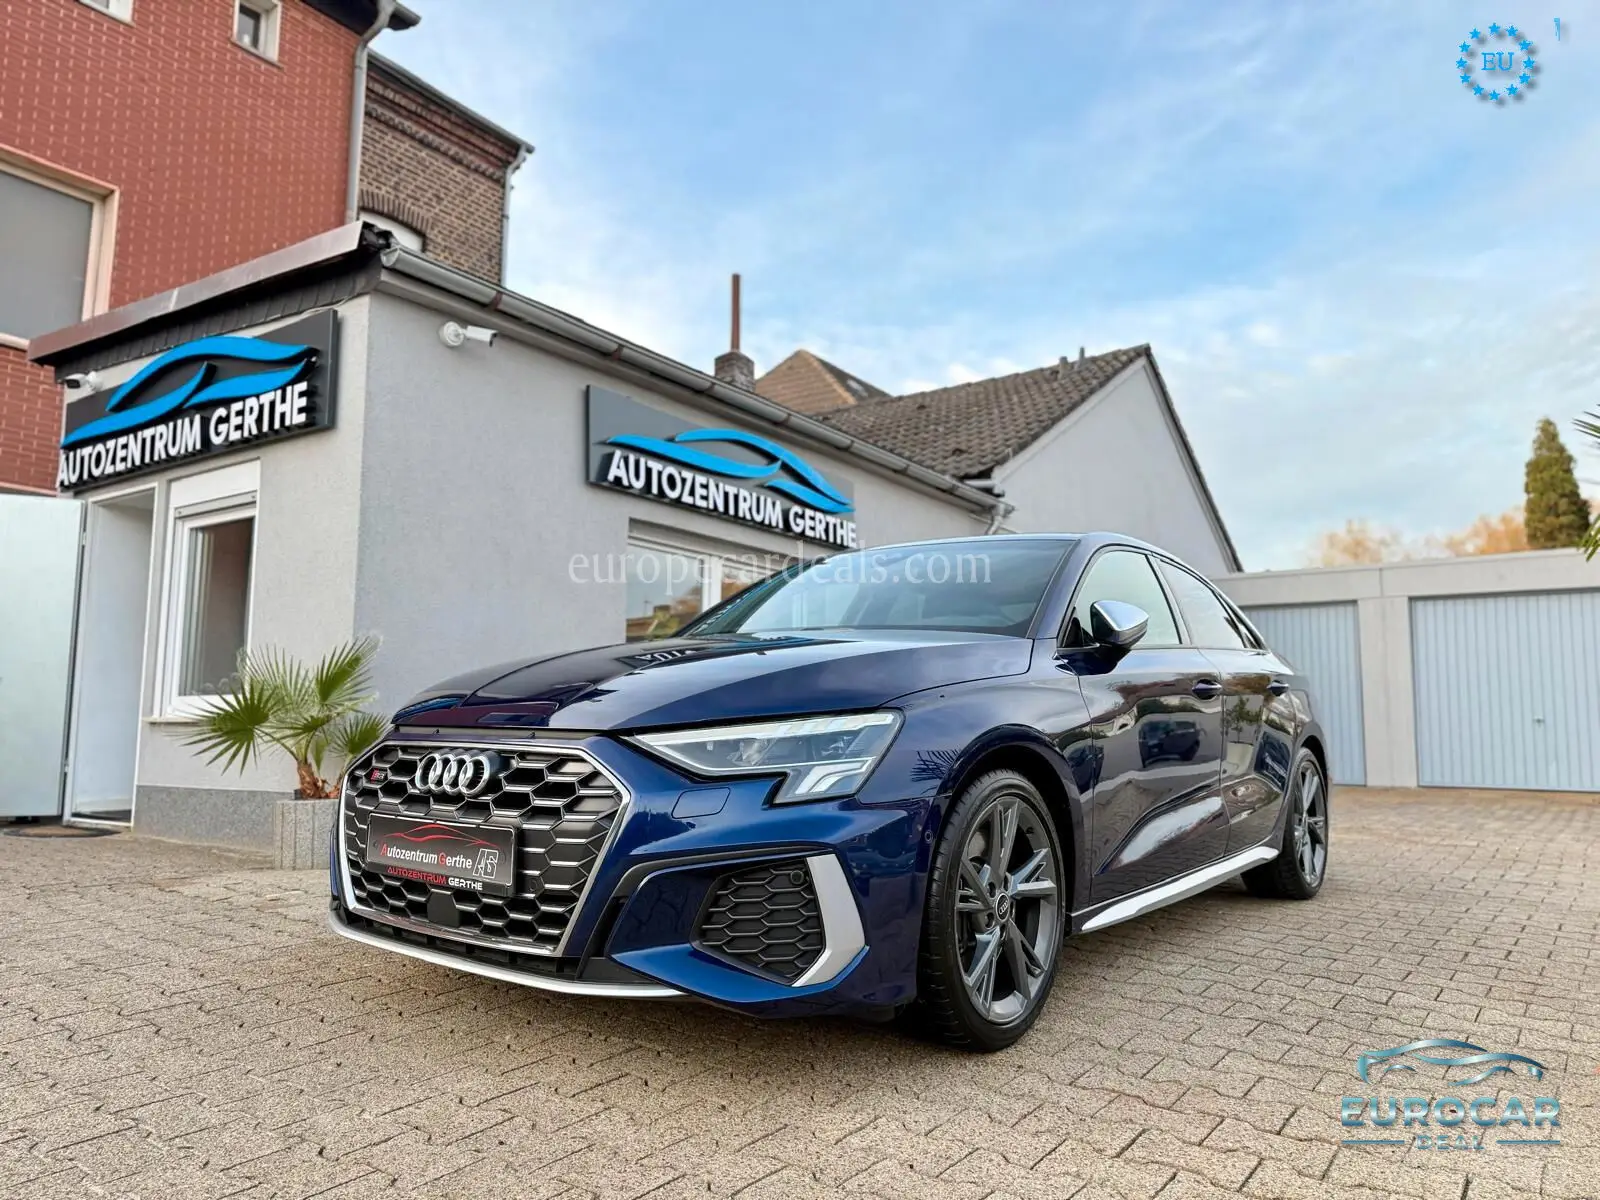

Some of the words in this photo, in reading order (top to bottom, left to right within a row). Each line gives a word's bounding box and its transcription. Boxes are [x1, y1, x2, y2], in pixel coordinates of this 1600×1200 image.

[56, 413, 201, 488] AUTOZENTRUM
[209, 381, 308, 446] GERTHE
[607, 449, 783, 528] AUTOZENTRUM
[788, 505, 857, 548] GERTHE
[380, 844, 438, 865] Autozentrum
[438, 851, 473, 869] Gerthe
[387, 865, 447, 885] AUTOZENTRUM
[448, 877, 483, 891] GERTHE
